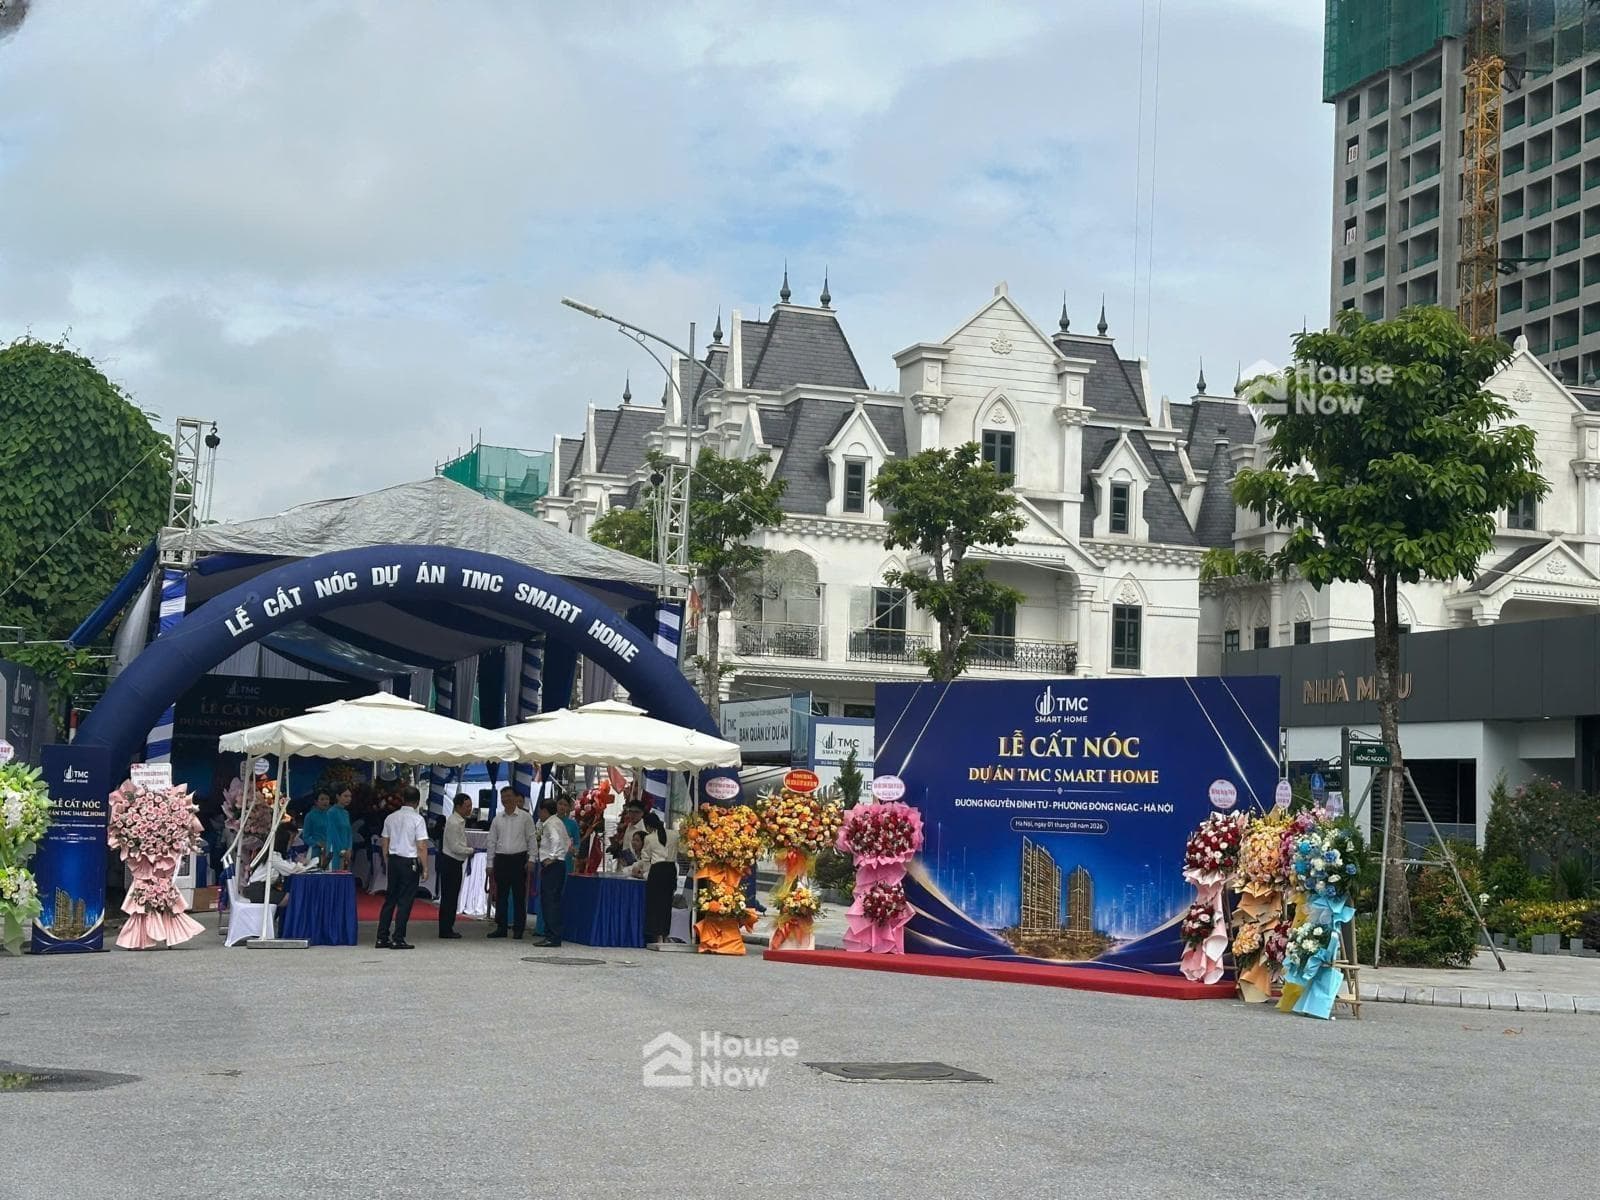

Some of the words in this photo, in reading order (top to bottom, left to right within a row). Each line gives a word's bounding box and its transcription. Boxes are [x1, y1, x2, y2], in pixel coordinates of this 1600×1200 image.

[224, 602, 254, 637] LỄ
[263, 586, 302, 617] CẤT
[314, 571, 358, 599] NÓC
[371, 564, 401, 587] DỰ
[416, 562, 445, 584] ÁN
[462, 568, 504, 593] TMC
[514, 583, 583, 624] SMART
[587, 619, 640, 663] HOME
[1303, 670, 1349, 704] NHÀ
[1356, 672, 1412, 700] MU
[1057, 697, 1088, 711] TMC
[1034, 715, 1061, 723] SMART
[1063, 715, 1088, 723] HOME
[740, 728, 749, 742] BAN
[750, 722, 764, 742] QUẢN
[772, 724, 780, 744] DỰ
[780, 721, 789, 741] ÁN
[837, 738, 860, 748] TMC
[998, 729, 1025, 758] LỄ
[1030, 729, 1077, 758] CẤT
[1083, 731, 1140, 758] NÓC
[74, 770, 89, 779] TMC
[969, 764, 992, 783] DỰ
[993, 764, 1015, 781] ÁN
[1017, 768, 1051, 782] TMC
[1054, 768, 1106, 783] SMART
[1109, 769, 1159, 784] HOME
[65, 797, 80, 808] CẤT
[1114, 802, 1139, 813] NGẠC
[1157, 802, 1174, 813] NỘI
